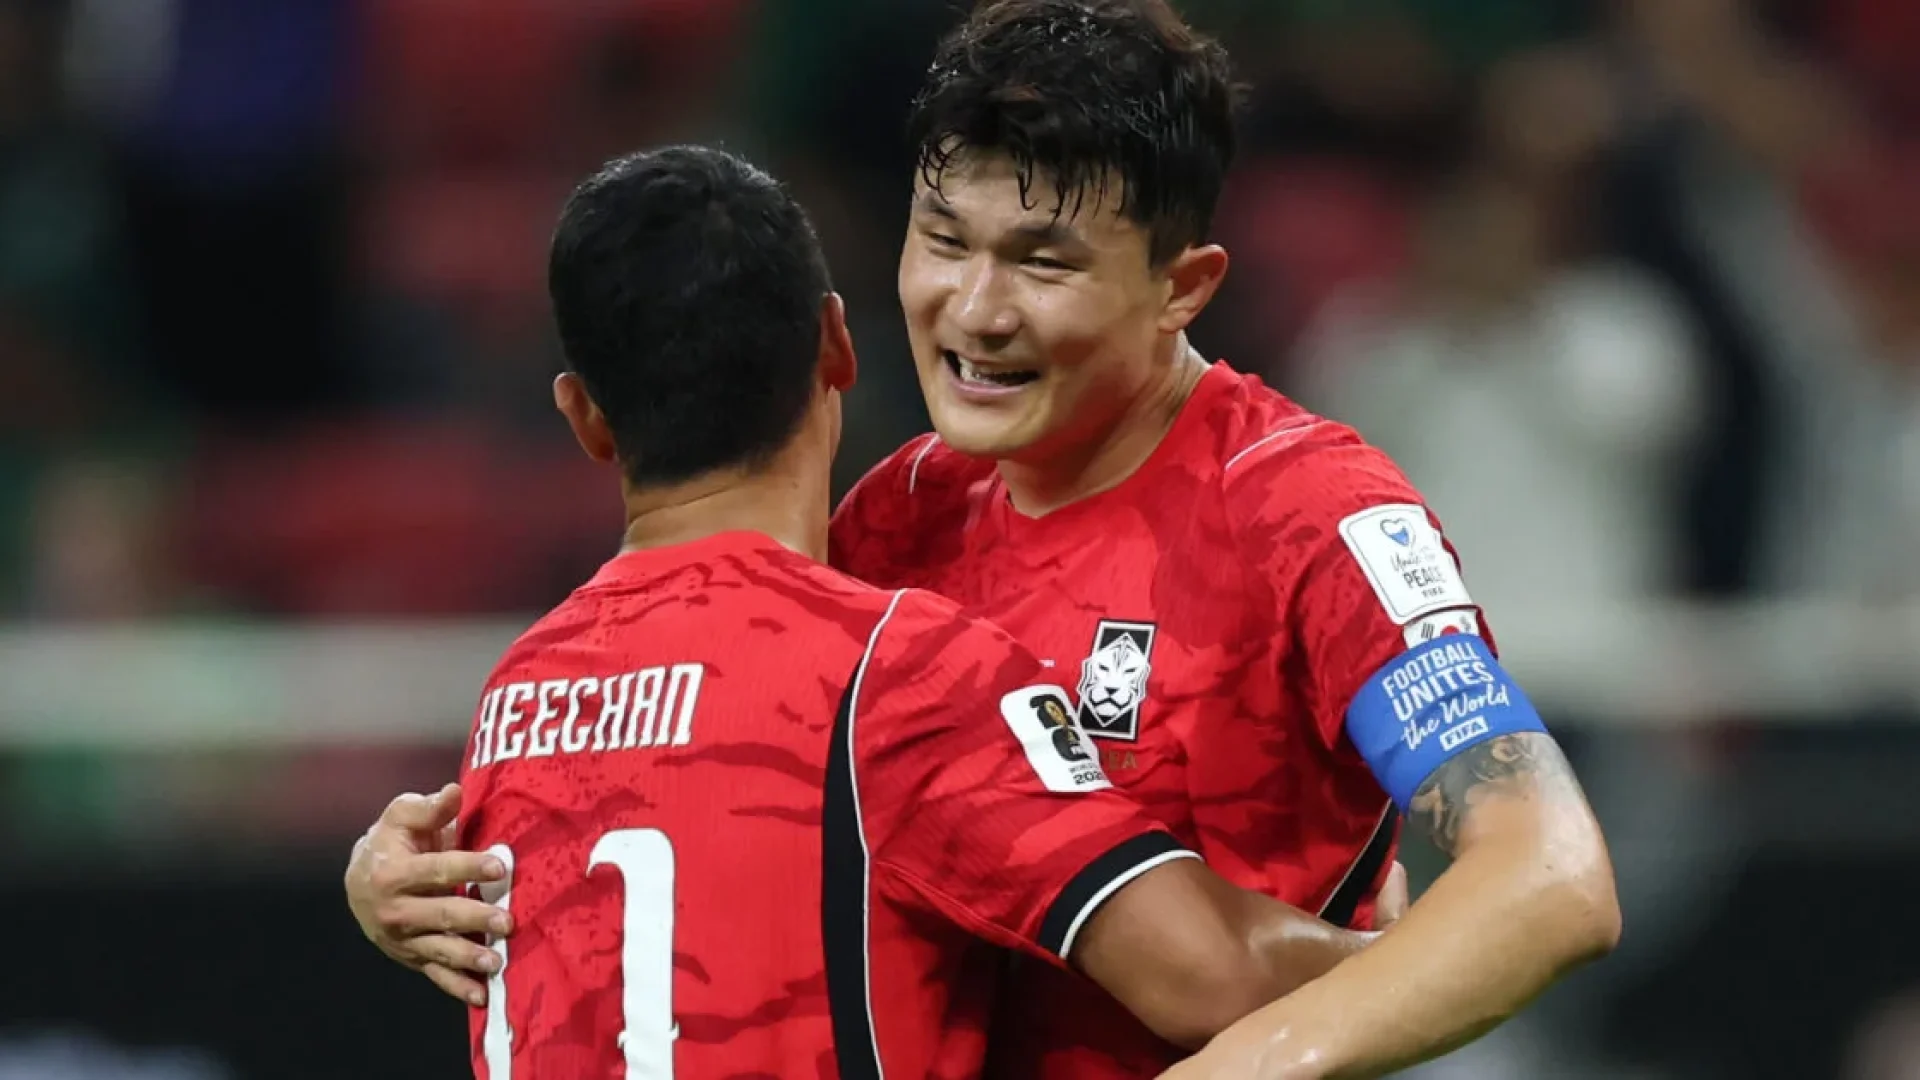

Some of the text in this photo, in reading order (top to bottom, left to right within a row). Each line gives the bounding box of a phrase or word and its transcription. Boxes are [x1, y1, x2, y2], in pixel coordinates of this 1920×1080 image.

[1402, 566, 1446, 588] PEACE
[1382, 642, 1481, 698] FOOTBALL
[1392, 660, 1495, 721] UNITES
[471, 662, 704, 769] HEECHAN
[1401, 684, 1510, 750] the World
[1442, 718, 1486, 748] FIFA
[465, 827, 680, 1080] 11
